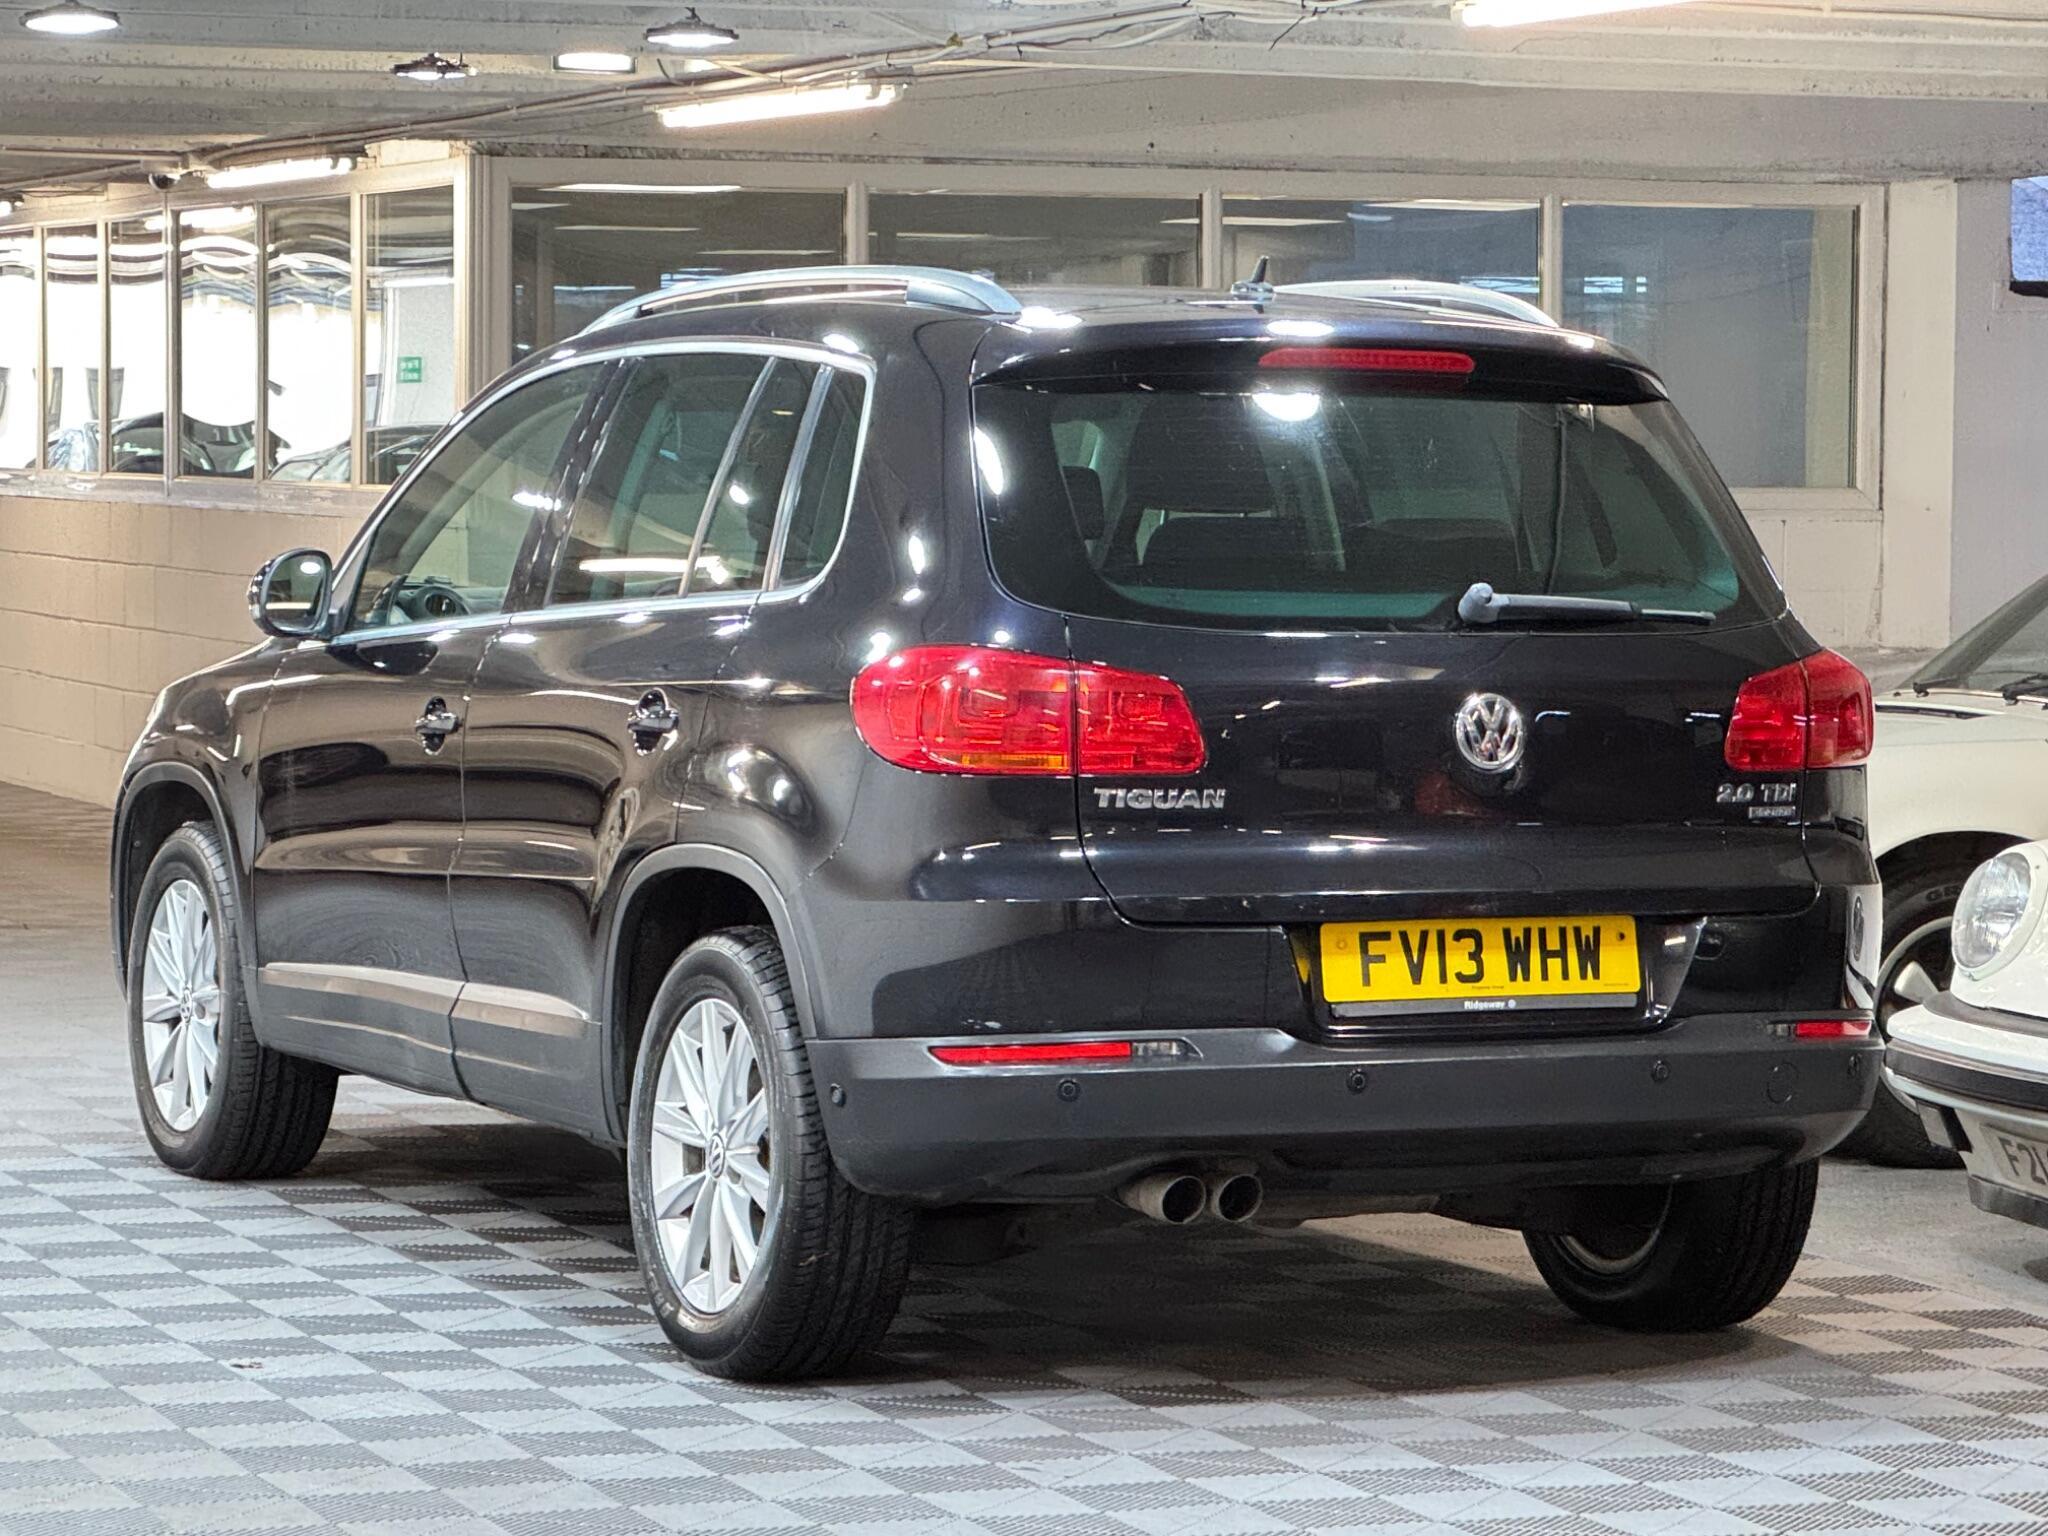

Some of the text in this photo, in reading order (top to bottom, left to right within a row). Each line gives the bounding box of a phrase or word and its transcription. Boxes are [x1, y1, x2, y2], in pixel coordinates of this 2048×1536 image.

[1093, 787, 1227, 809] TIGUAN
[1760, 782, 1797, 803] TDI
[1358, 926, 1601, 987] FV13 WHW
[1463, 1000, 1506, 1011] Ridgeway
